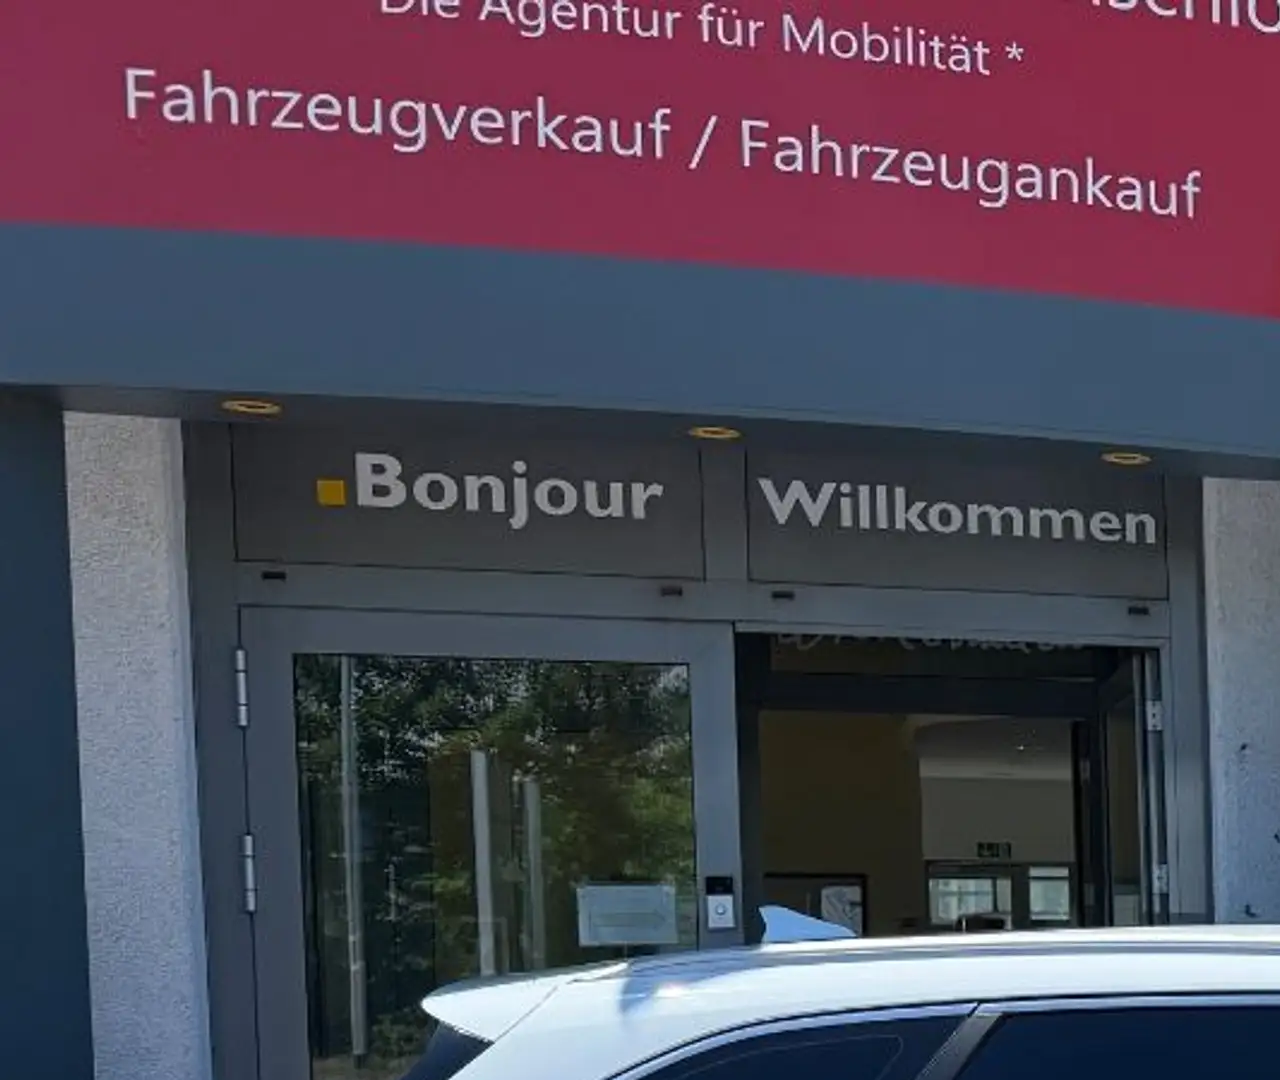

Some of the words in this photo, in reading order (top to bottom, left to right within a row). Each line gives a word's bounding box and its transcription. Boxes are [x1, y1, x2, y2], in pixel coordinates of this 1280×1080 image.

[478, 0, 682, 39] Agentur
[697, 2, 765, 48] für
[781, 13, 991, 77] Mobilität
[124, 66, 672, 160] Fahrzeugverkauf
[740, 118, 1202, 219] Fahrzeugankauf
[354, 451, 665, 530] Bonjour
[756, 476, 1157, 545] Willkommen
